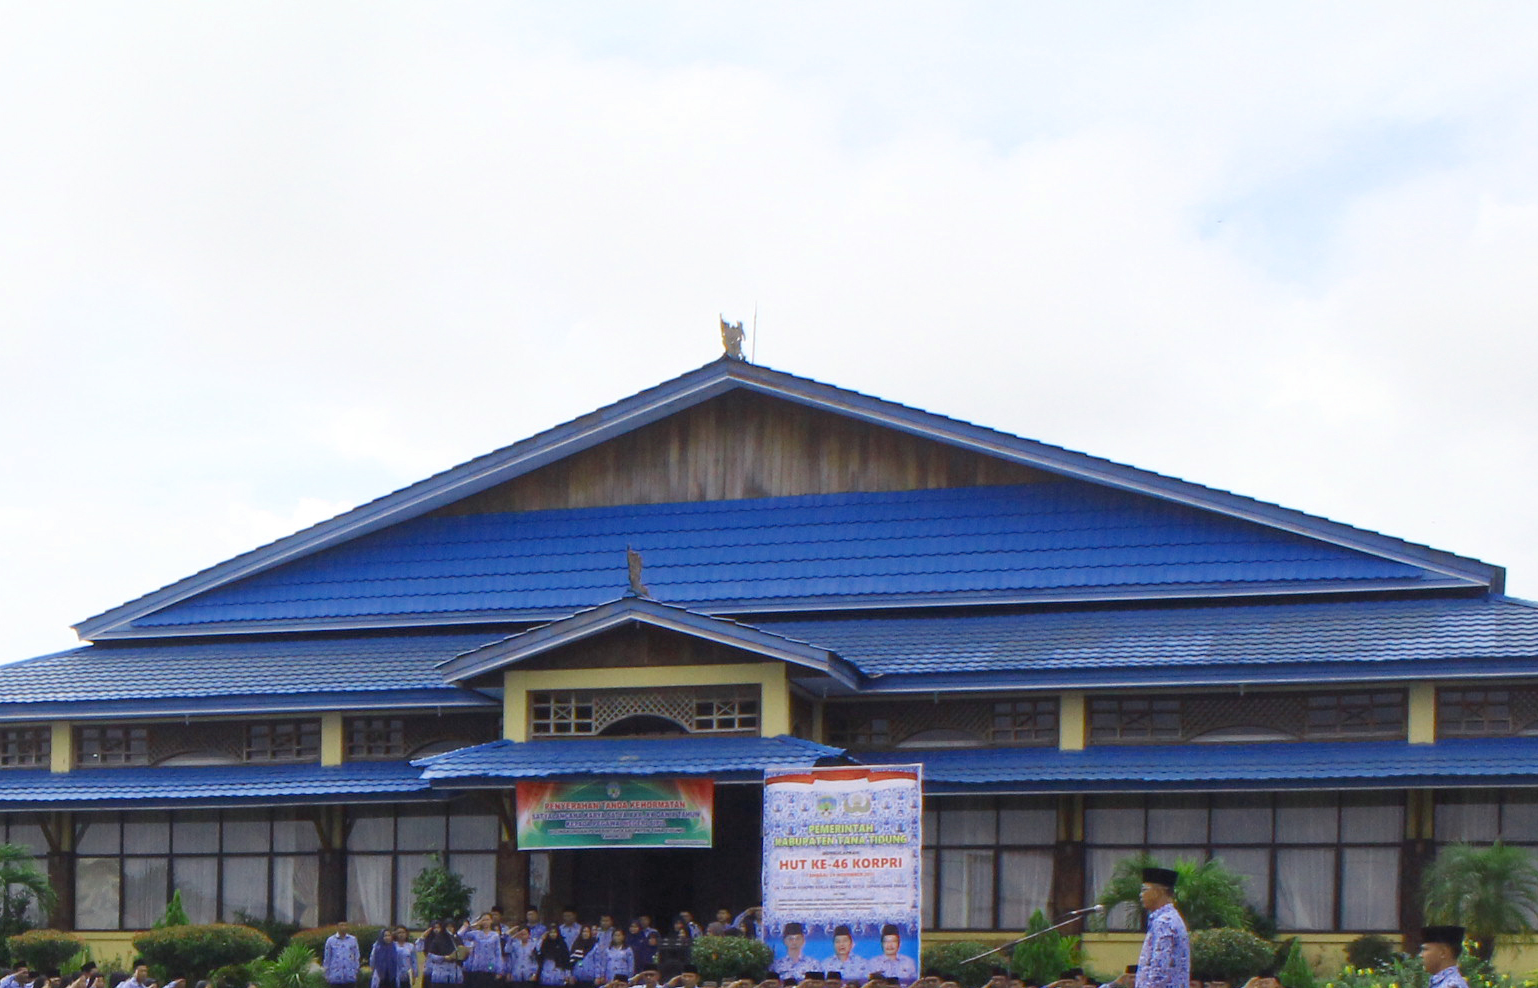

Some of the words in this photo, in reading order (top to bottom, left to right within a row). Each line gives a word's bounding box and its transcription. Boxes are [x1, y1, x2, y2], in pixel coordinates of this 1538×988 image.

[545, 802, 599, 810] PENYERAHAN
[603, 801, 627, 809] TANDA
[629, 801, 686, 809] KEHORMATAN
[808, 824, 875, 834] PEMERINTAH
[774, 836, 834, 847] KABUPATEN
[837, 835, 865, 846] TANA
[868, 834, 908, 845] TIDUNG
[779, 859, 807, 870] HUT
[811, 858, 848, 870] KE-46
[852, 857, 902, 869] KORPRI
